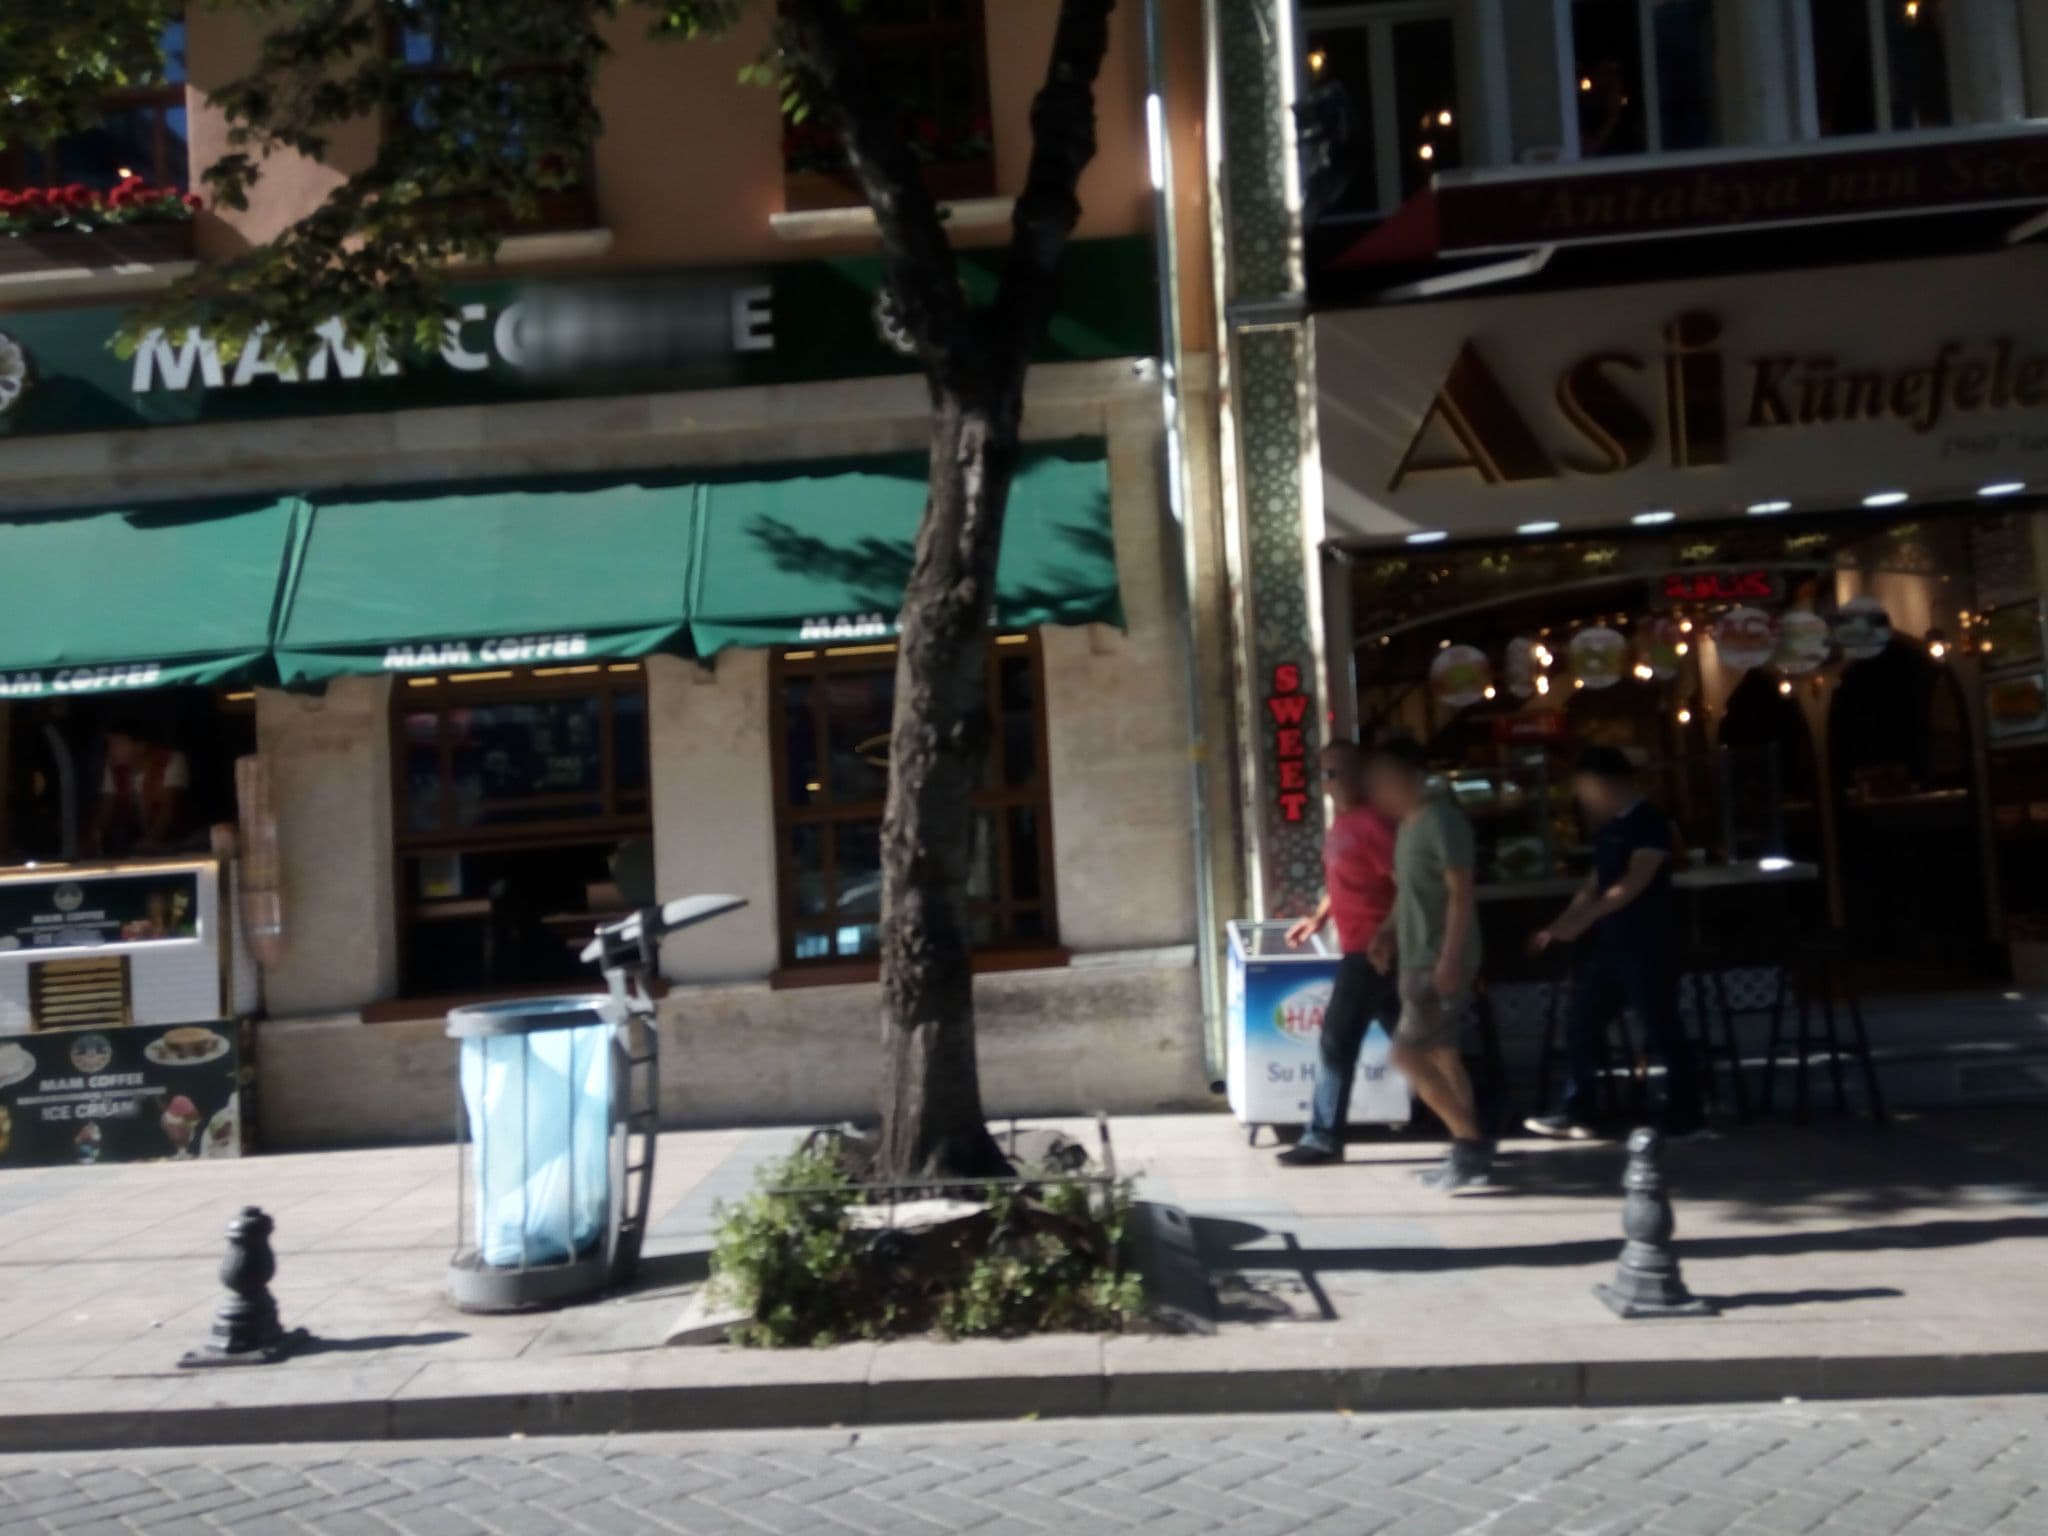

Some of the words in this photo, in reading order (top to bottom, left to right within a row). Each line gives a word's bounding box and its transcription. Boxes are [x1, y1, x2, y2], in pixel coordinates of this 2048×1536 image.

[800, 610, 886, 640] MAM
[382, 641, 472, 667] MAM
[479, 633, 587, 662] COFFEE
[51, 663, 161, 692] COFFEE
[1267, 664, 1309, 822] SWEET
